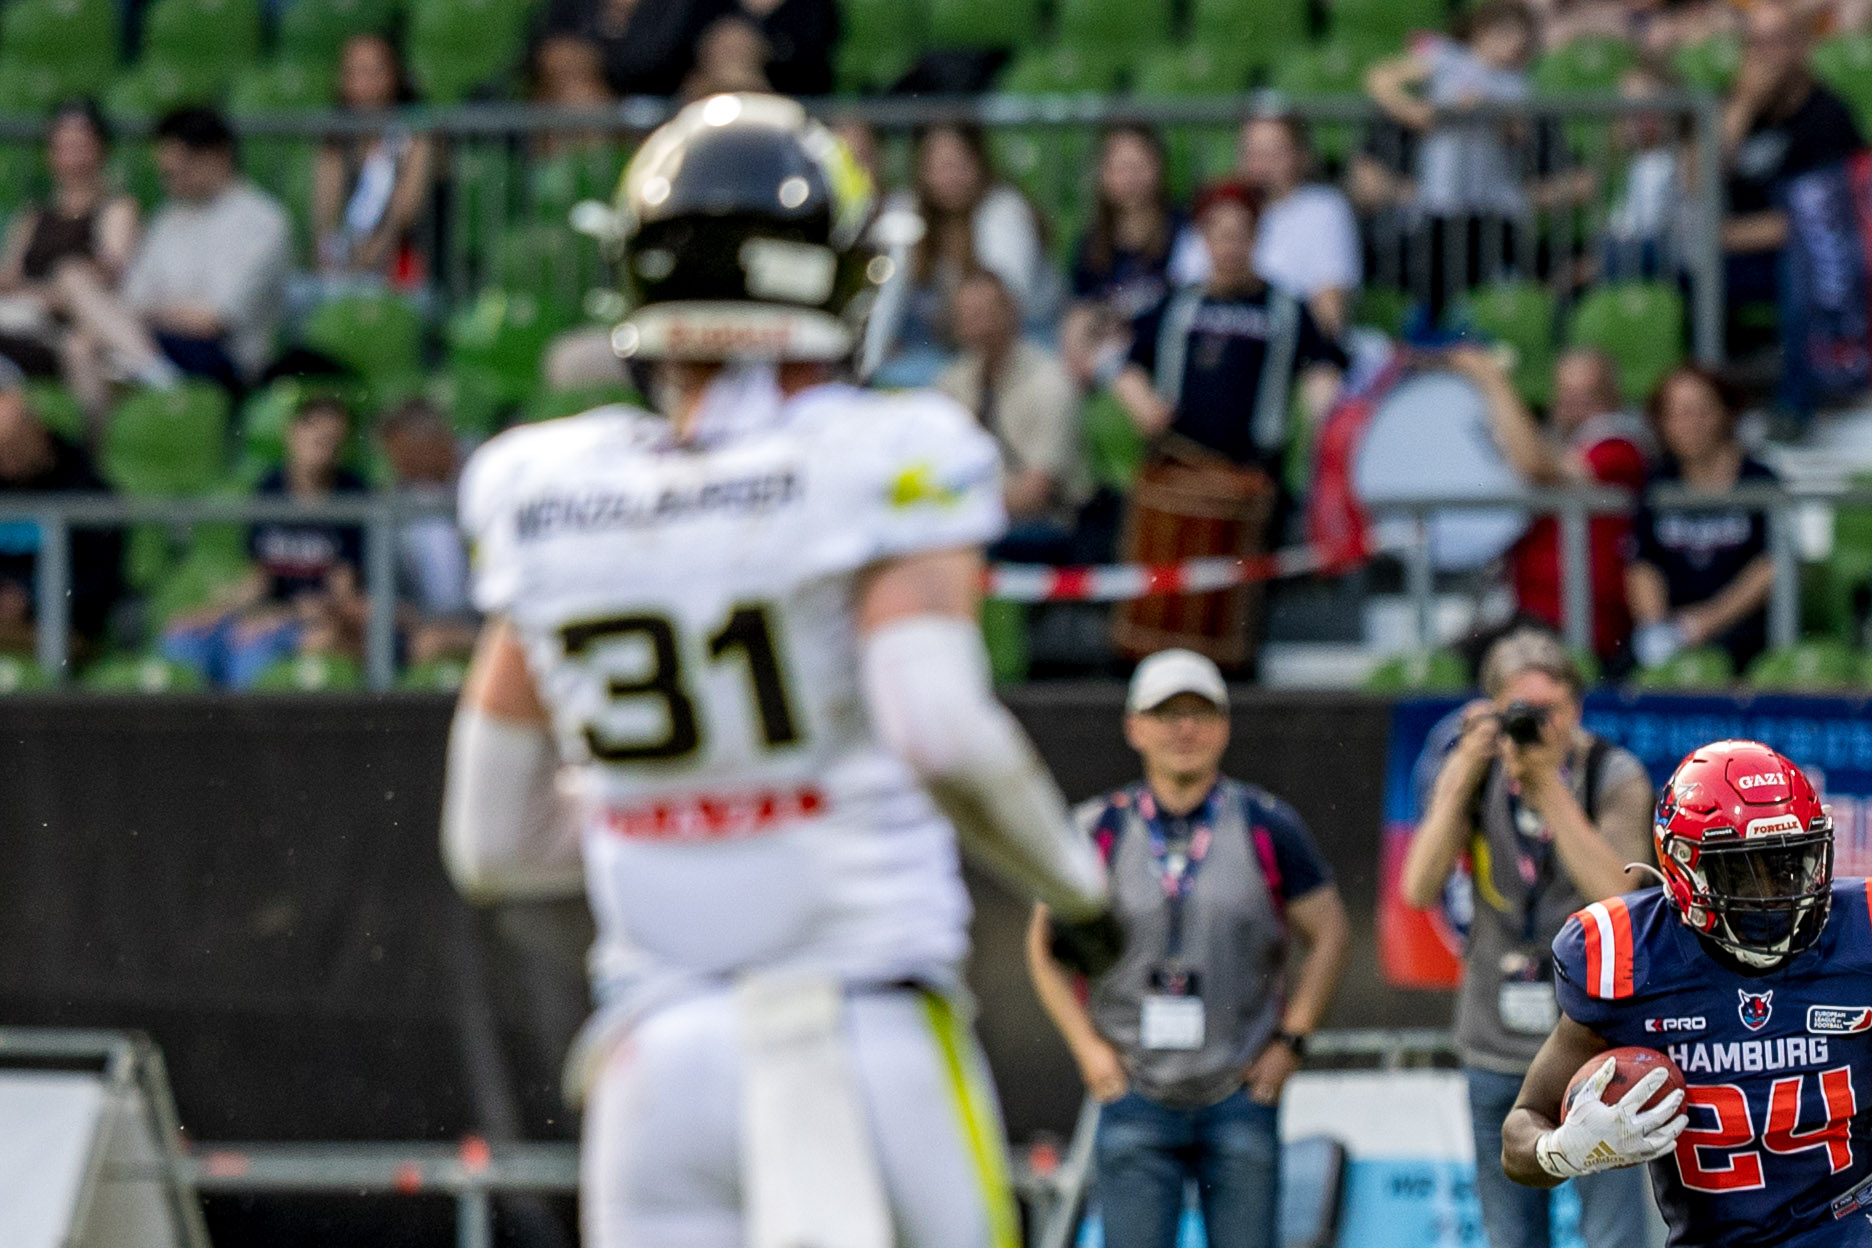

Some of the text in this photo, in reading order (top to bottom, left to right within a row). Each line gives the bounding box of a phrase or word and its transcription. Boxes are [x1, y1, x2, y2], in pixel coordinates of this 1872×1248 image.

[560, 602, 801, 762] 31
[1738, 772, 1787, 789] GAZI
[1754, 821, 1798, 835] FORELLE
[1667, 1036, 1829, 1073] HAMBURG
[1673, 1064, 1858, 1193] 24
[1583, 1156, 1625, 1168] adidas
